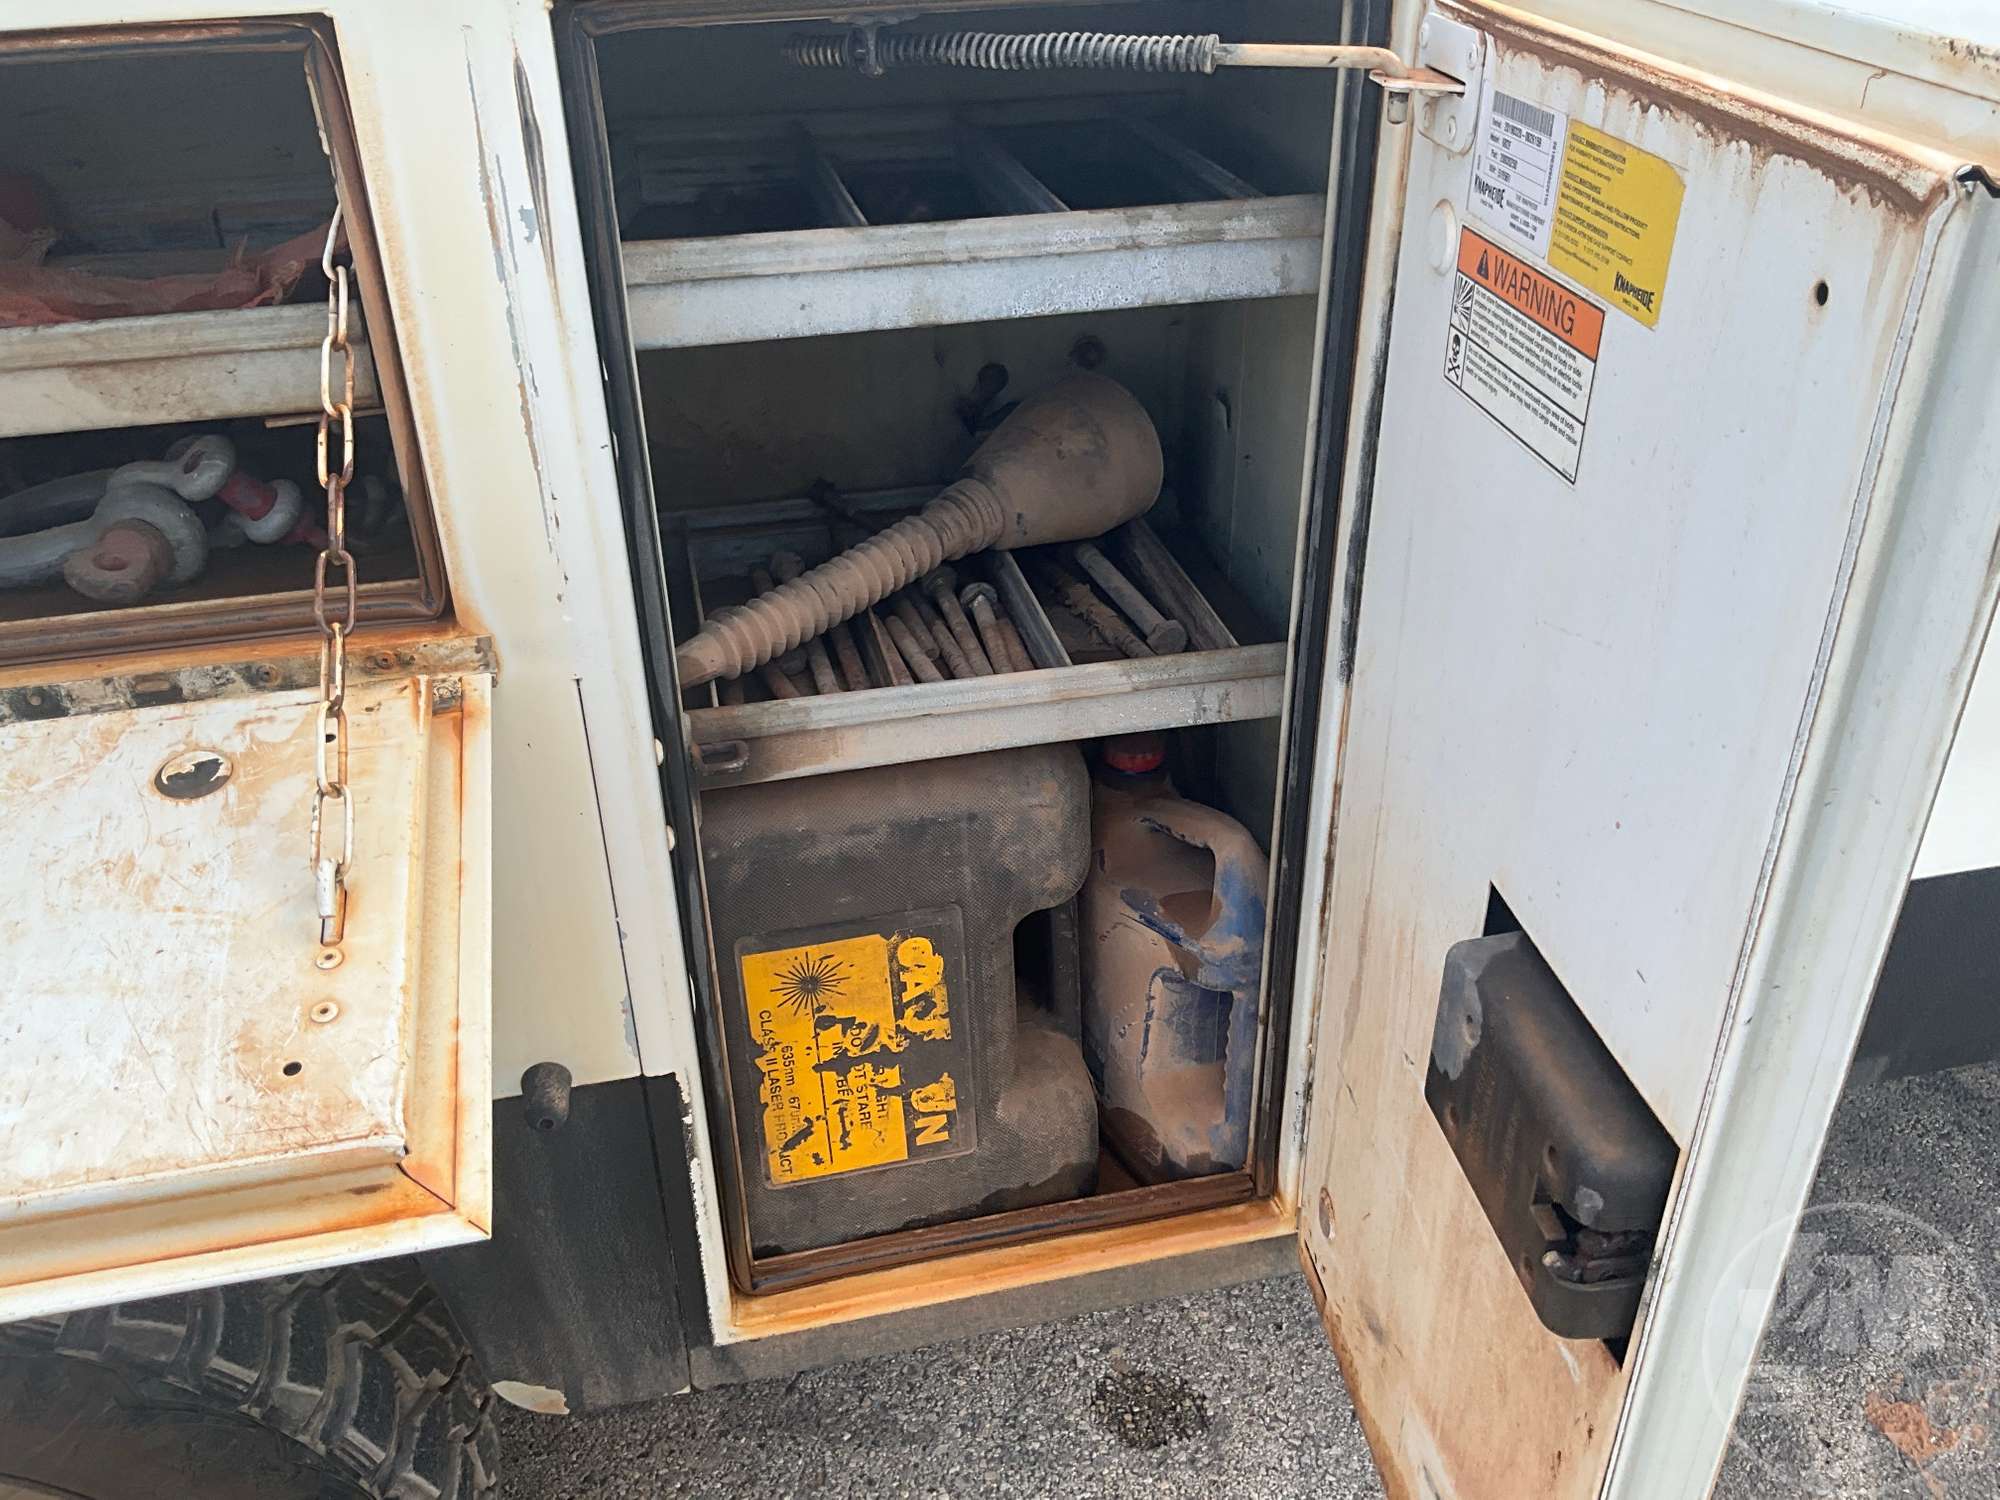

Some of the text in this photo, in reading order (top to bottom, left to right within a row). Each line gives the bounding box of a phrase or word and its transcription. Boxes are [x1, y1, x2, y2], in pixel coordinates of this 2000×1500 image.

[1473, 173, 1505, 208] KNAPHEIDE
[1494, 255, 1576, 336] WARNING
[1613, 269, 1656, 314] KNAPHEIDE
[848, 1026, 863, 1048] DO
[765, 1057, 777, 1065] II
[780, 1044, 797, 1086] 635nm
[767, 1068, 783, 1111] LASER
[855, 1084, 872, 1130] STARE
